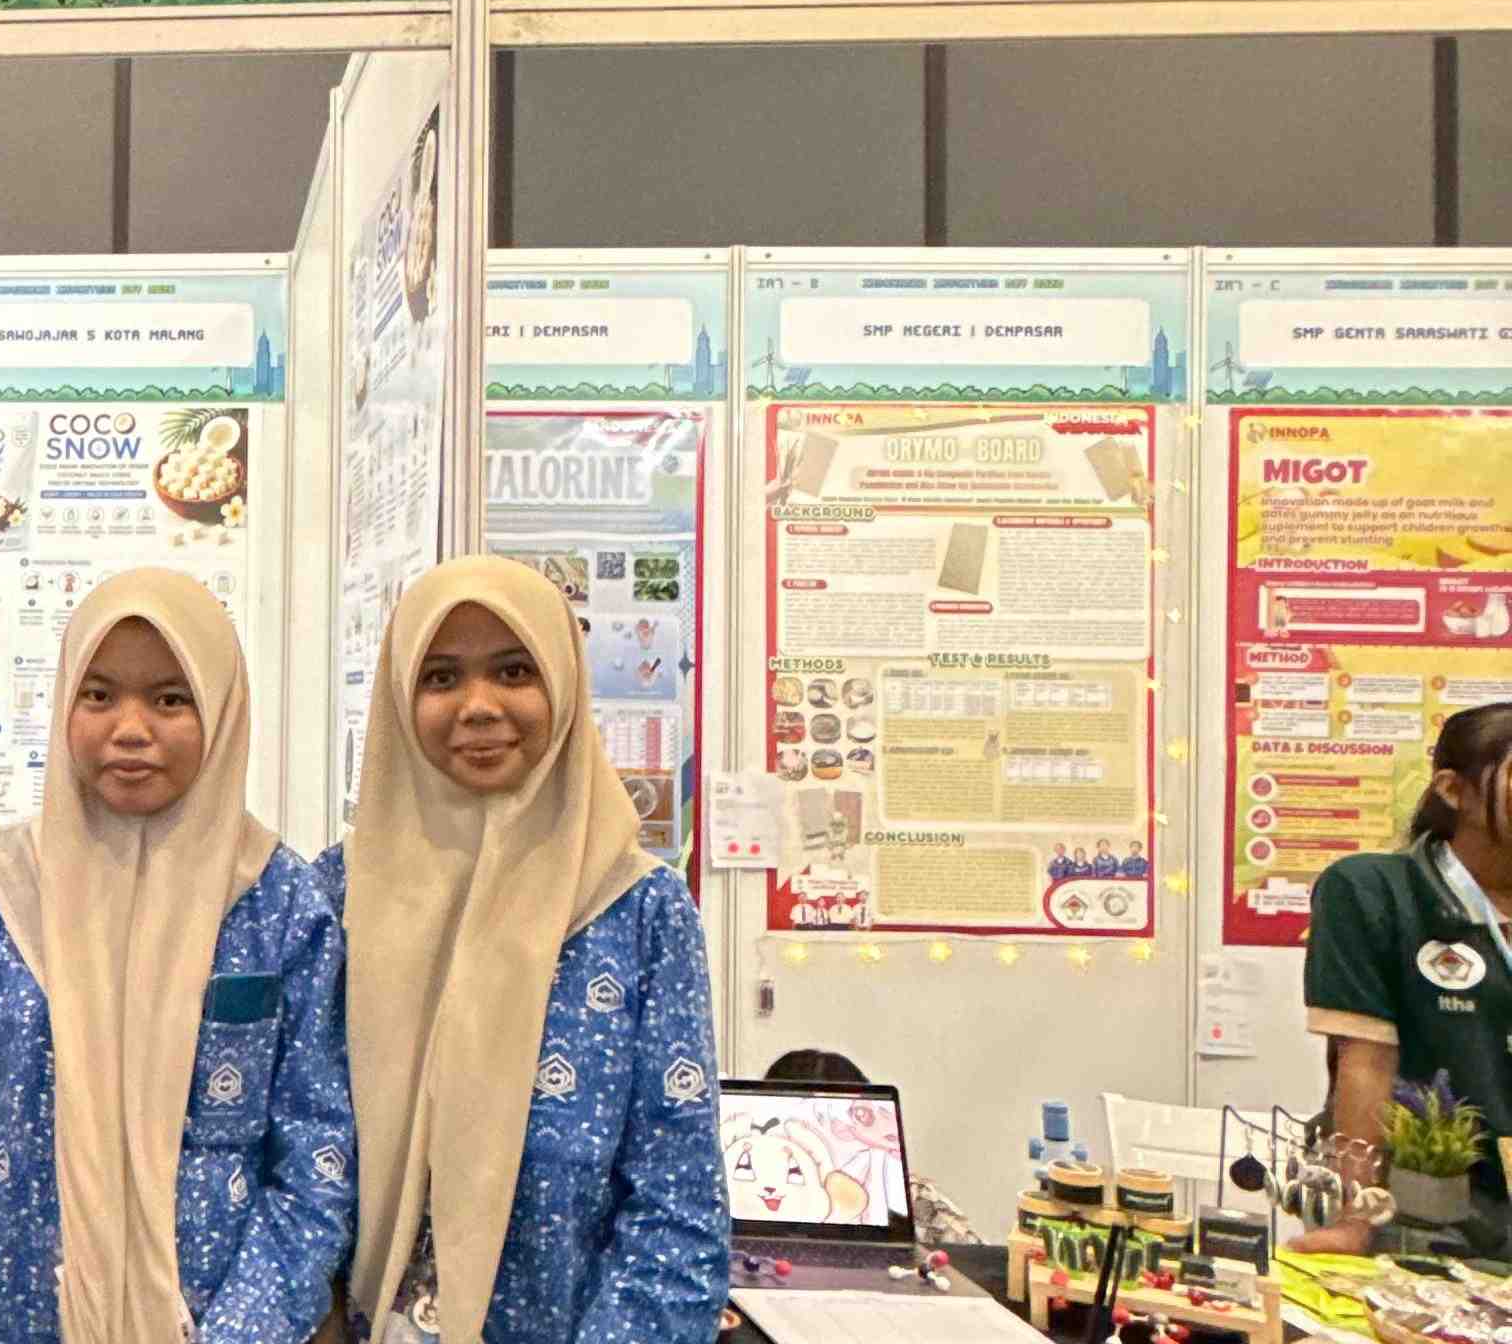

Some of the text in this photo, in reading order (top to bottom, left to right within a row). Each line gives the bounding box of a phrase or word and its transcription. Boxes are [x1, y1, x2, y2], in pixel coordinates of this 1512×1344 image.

[87, 329, 96, 342] 5
[104, 329, 141, 342] KOTA
[149, 329, 205, 342] MALANG
[533, 325, 609, 337] DENPASAR
[863, 325, 893, 337] SMP
[903, 325, 962, 337] NEGERI
[984, 325, 1063, 338] DENPASAR
[1292, 327, 1324, 340] SMP
[1335, 327, 1385, 340] GENTA
[1395, 327, 1489, 340] SARASWATI
[49, 412, 136, 436] COCO
[1270, 427, 1330, 439] INNOPA
[46, 436, 142, 461] SNOW
[887, 437, 1041, 463] ORYMO BOARD
[1263, 459, 1368, 484] MIGOT
[1332, 497, 1369, 507] made
[1371, 497, 1388, 509] up
[1390, 497, 1405, 507] of
[1407, 497, 1436, 509] goat
[1438, 497, 1467, 507] milk
[1469, 497, 1494, 508] and
[773, 507, 874, 519] BACKGROUND
[1299, 510, 1348, 522] gummy
[1351, 509, 1378, 522] jelly
[1380, 512, 1396, 520] as
[1399, 512, 1415, 520] an
[1418, 509, 1478, 520] nutritious
[1331, 523, 1345, 532] to
[1347, 523, 1397, 535] support
[1401, 522, 1455, 533] children
[1261, 534, 1394, 547] and prevent stunting
[1257, 558, 1369, 570] INTRODUCTION
[932, 654, 971, 667] TEST
[987, 654, 1051, 667] RESULTS
[1249, 652, 1310, 664] METHOD
[770, 659, 843, 671] METHODS
[1251, 742, 1291, 754] DATA
[1308, 743, 1395, 755] DISCUSSION
[865, 831, 963, 843] CONCLUSION
